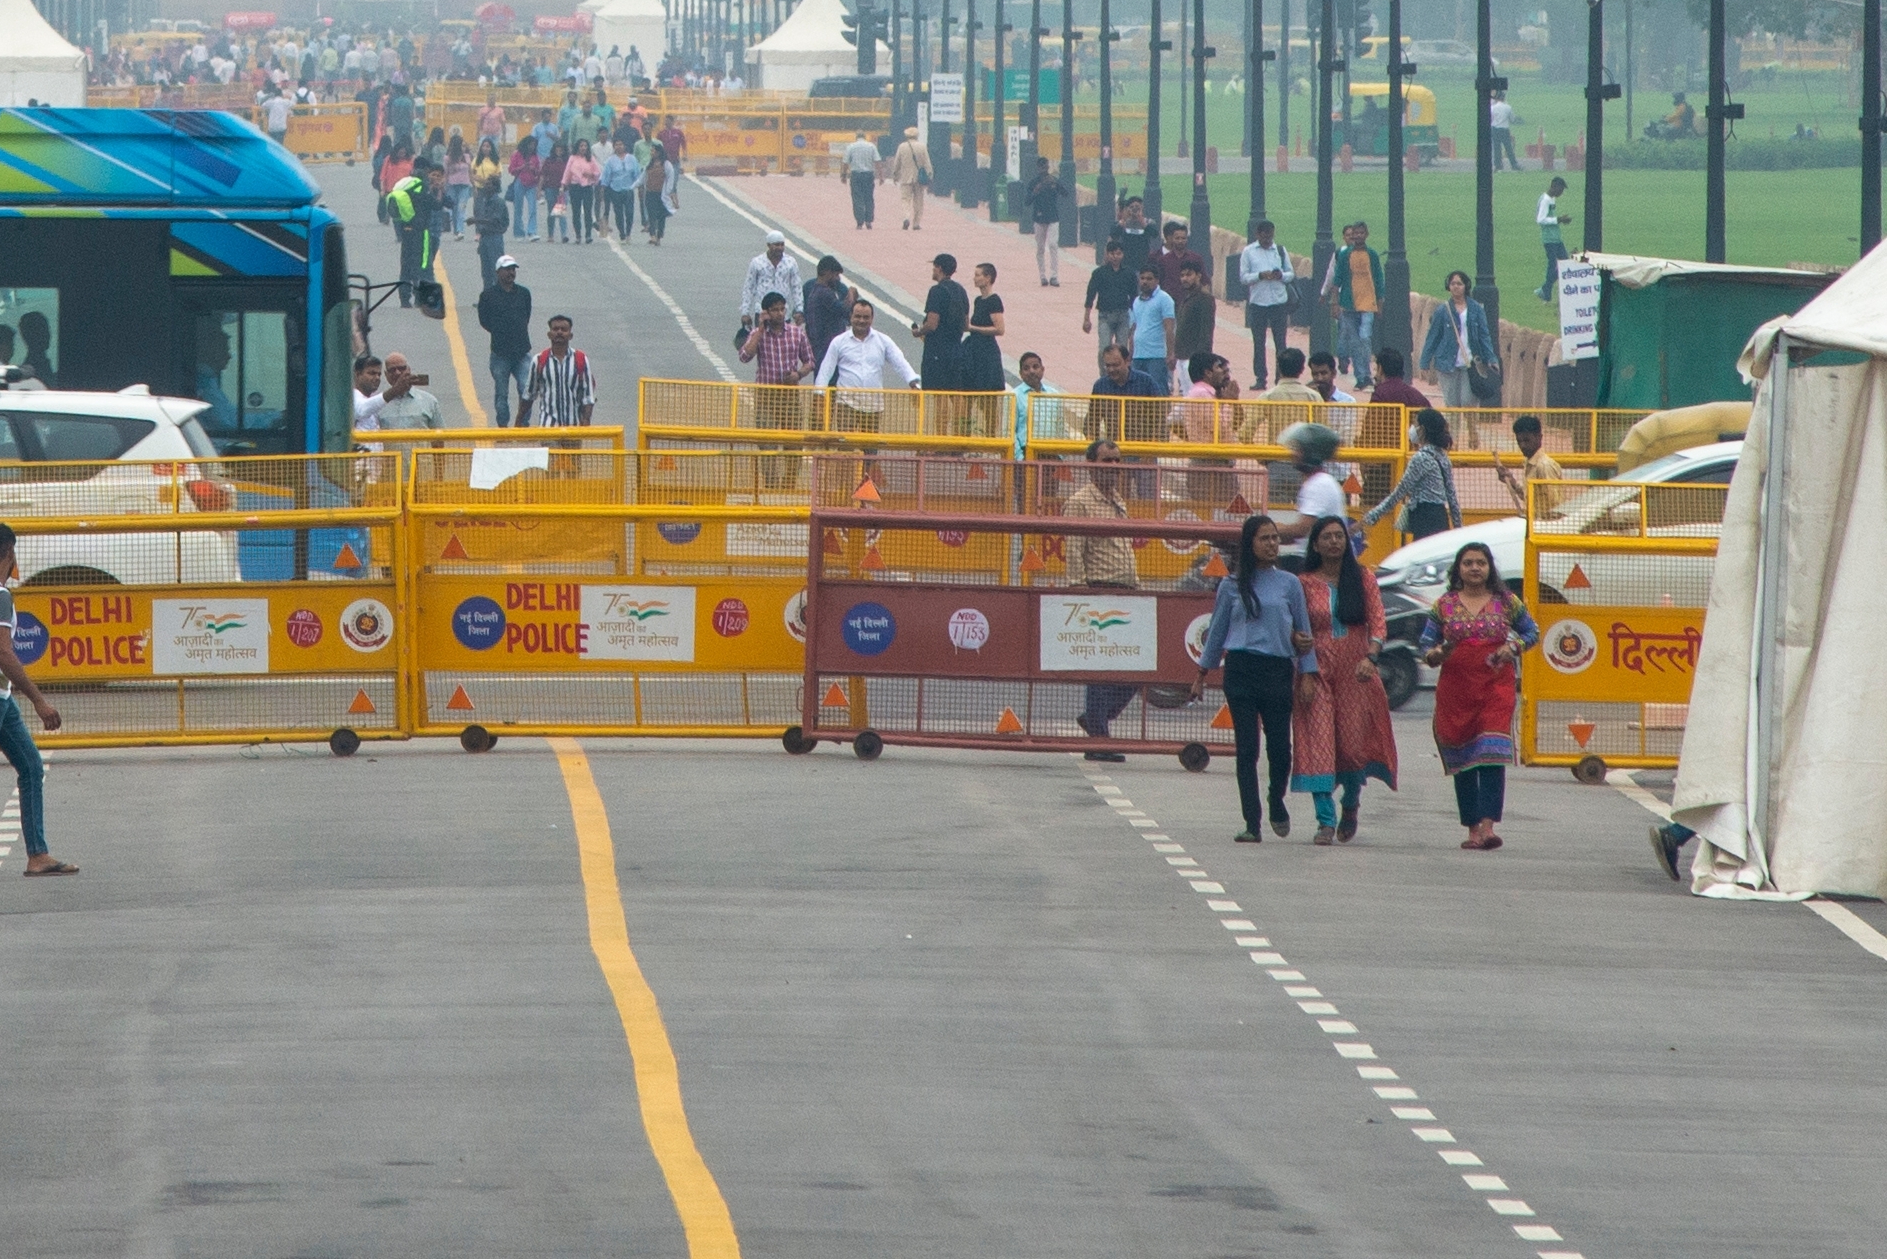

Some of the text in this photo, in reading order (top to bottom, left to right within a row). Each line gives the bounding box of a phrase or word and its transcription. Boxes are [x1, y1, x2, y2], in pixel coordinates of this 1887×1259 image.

[1564, 324, 1593, 335] DRINKING
[506, 583, 581, 611] DELHI
[50, 596, 133, 625] DELHI
[506, 623, 590, 654] POLICE
[607, 632, 679, 650] अमृत महोत्सव
[50, 635, 146, 667] POLICE
[185, 645, 257, 663] अमृत महोत्सव
[1069, 643, 1141, 660] अमृत महोत्सव
